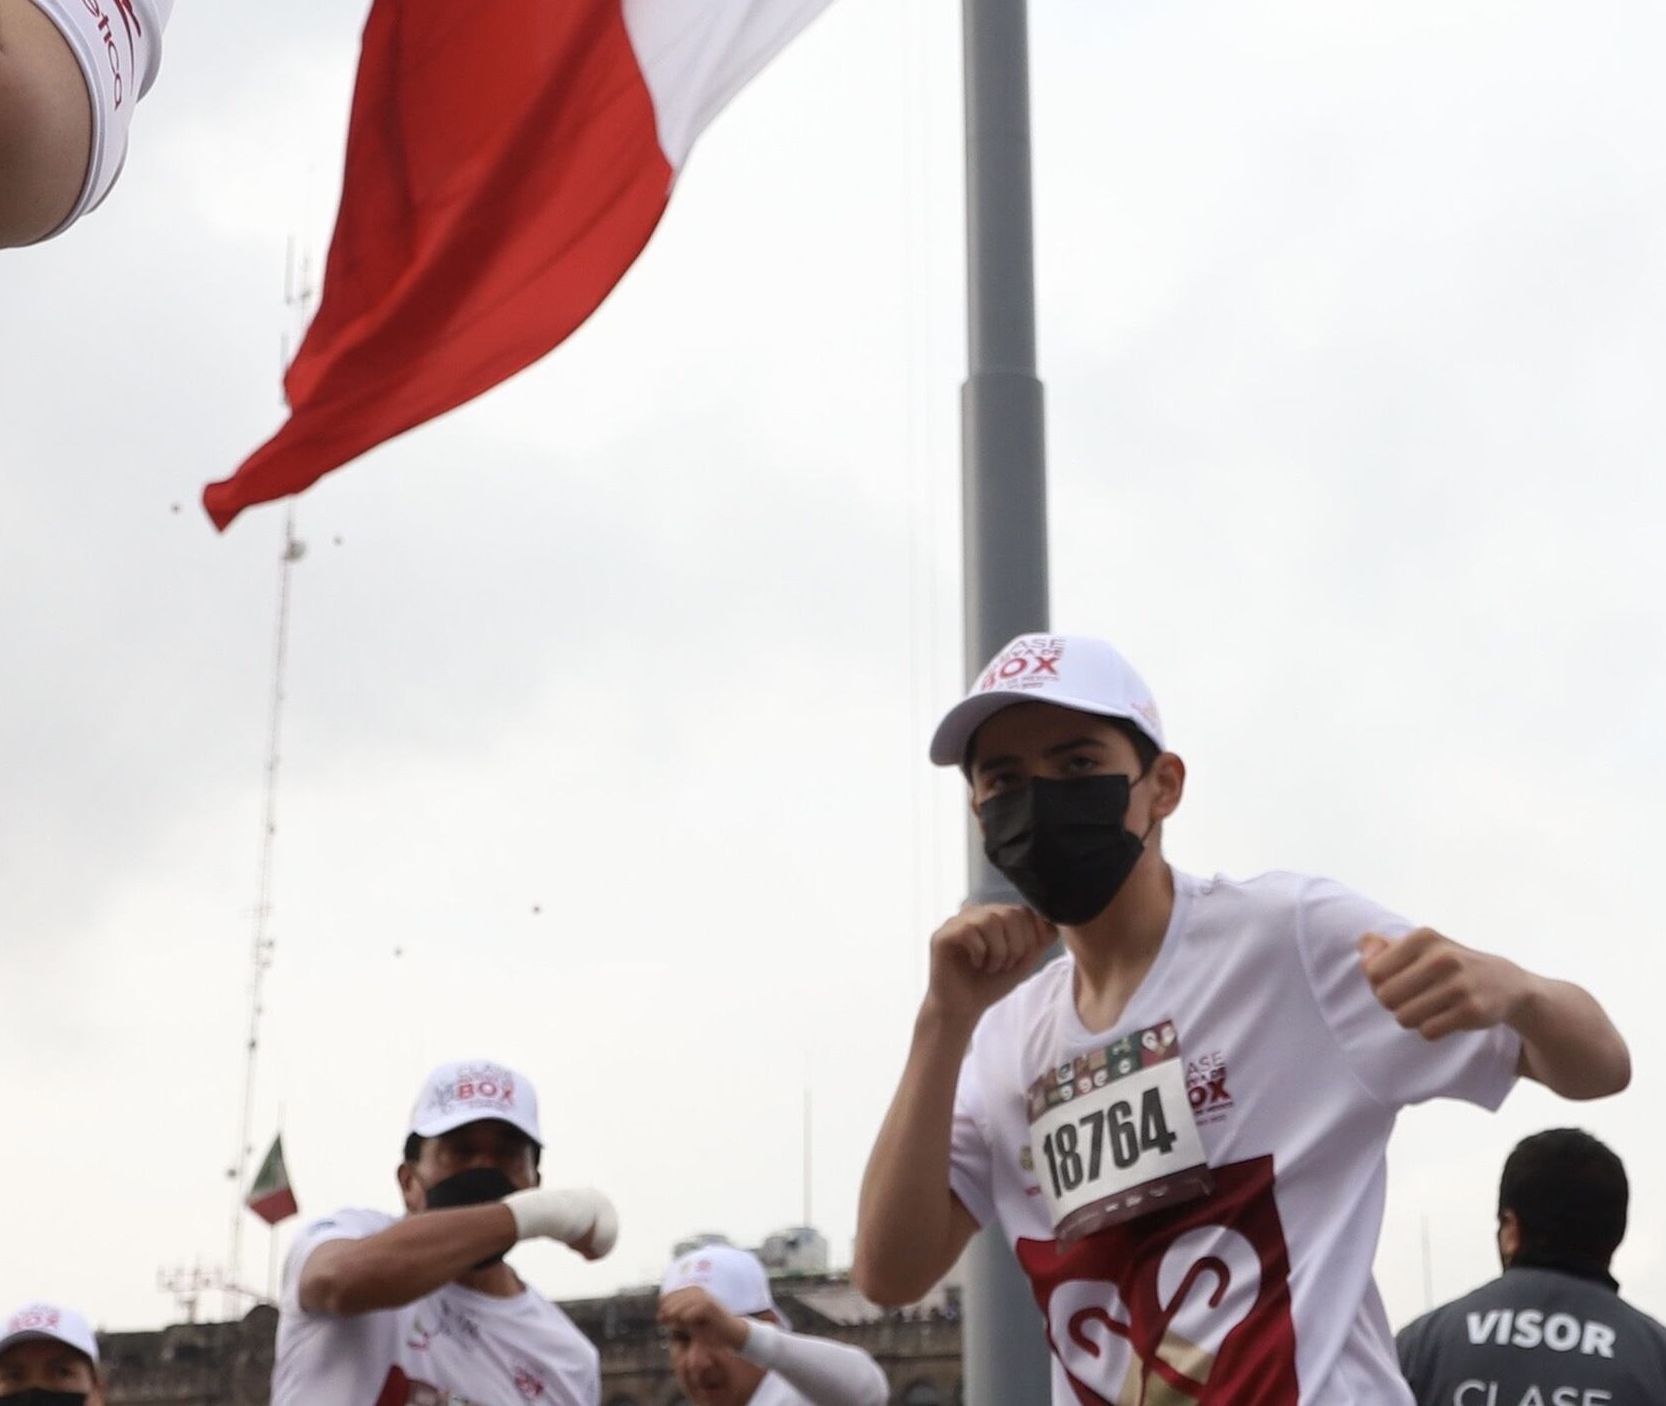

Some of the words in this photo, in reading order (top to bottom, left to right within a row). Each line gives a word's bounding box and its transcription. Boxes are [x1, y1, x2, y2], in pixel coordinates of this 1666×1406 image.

[1010, 637, 1065, 652] ASE
[459, 1081, 515, 1105] BOX
[1188, 1078, 1231, 1109] OX
[1043, 1086, 1177, 1200] 18764
[1466, 1308, 1617, 1359] VISOR
